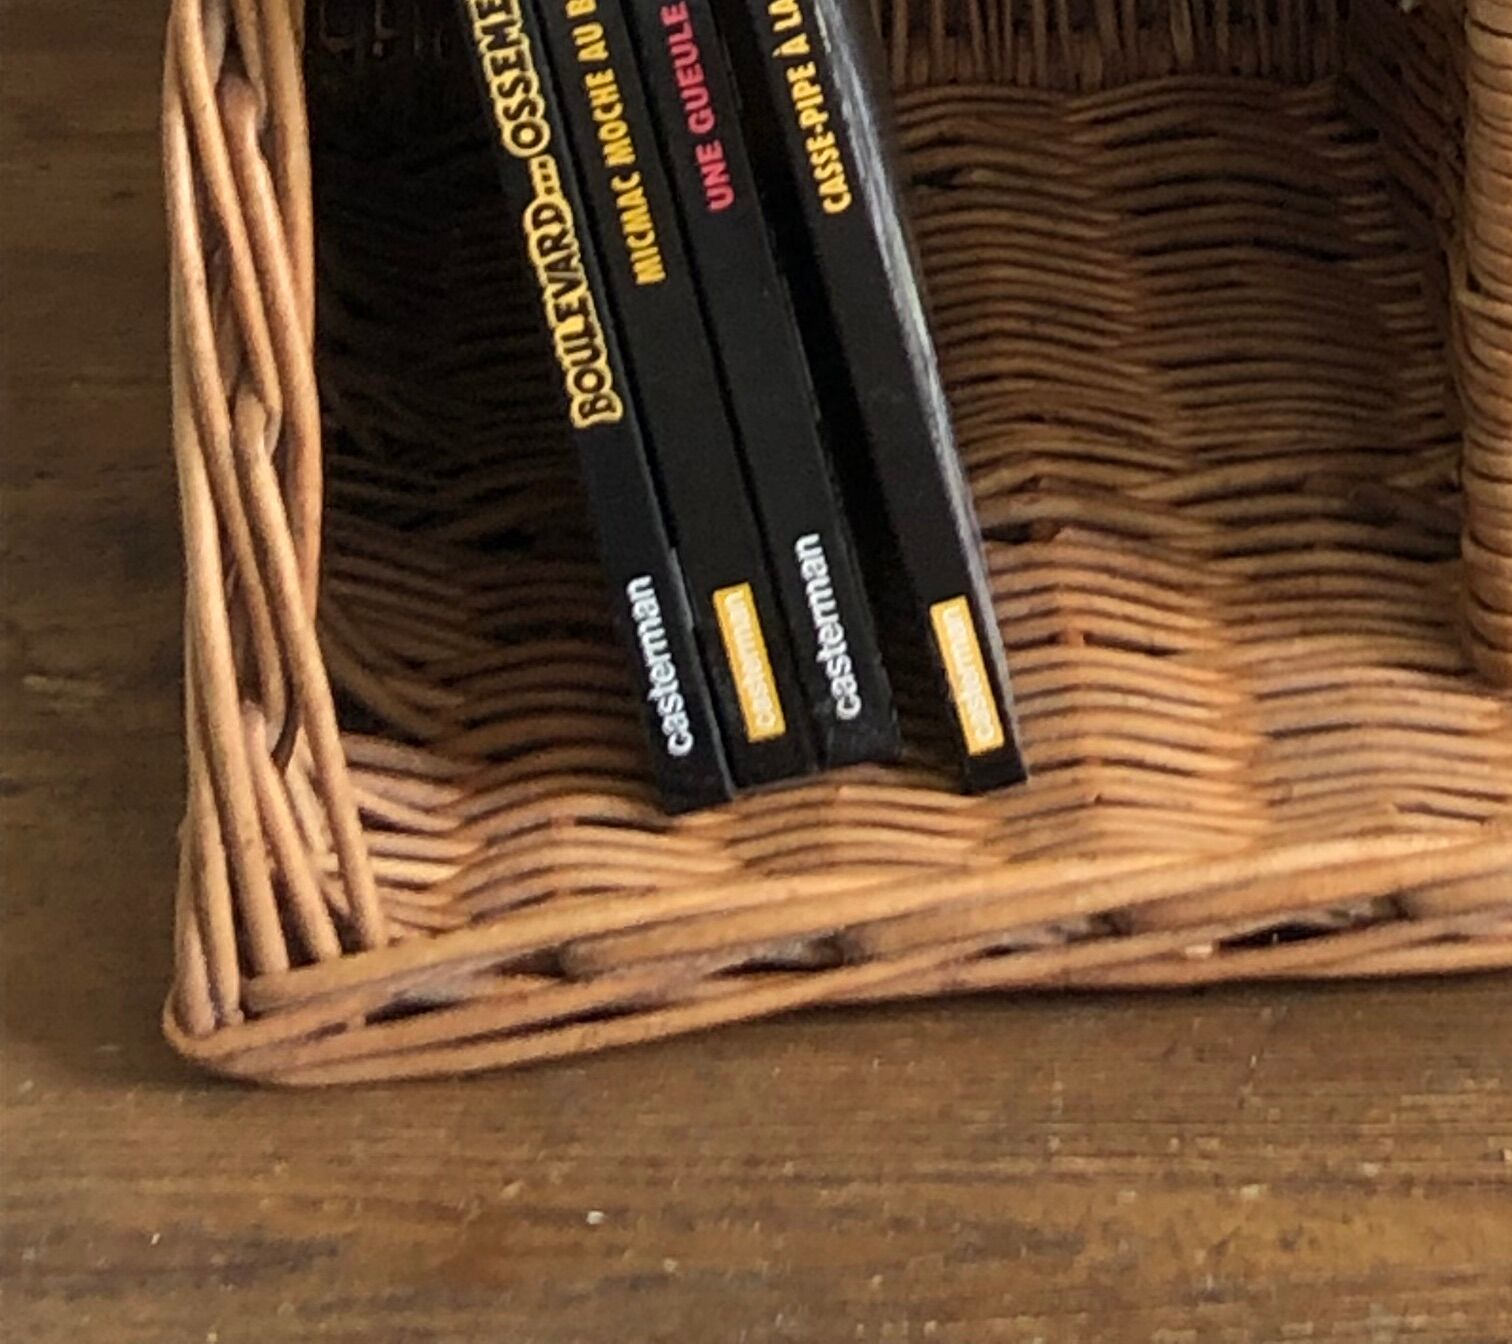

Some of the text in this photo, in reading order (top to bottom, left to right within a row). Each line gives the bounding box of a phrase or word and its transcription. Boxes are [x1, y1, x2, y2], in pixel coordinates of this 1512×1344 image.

[574, 22, 610, 63] AU
[660, 1, 717, 134] GUEULE
[773, 33, 811, 58] À
[586, 69, 636, 167] MOCHE
[699, 140, 735, 211] UNE
[786, 61, 853, 213] CASSE-PIPE
[611, 171, 666, 285] MICMAC
[625, 575, 694, 757] casterman
[722, 590, 777, 731] casterman
[795, 533, 862, 720] casterman
